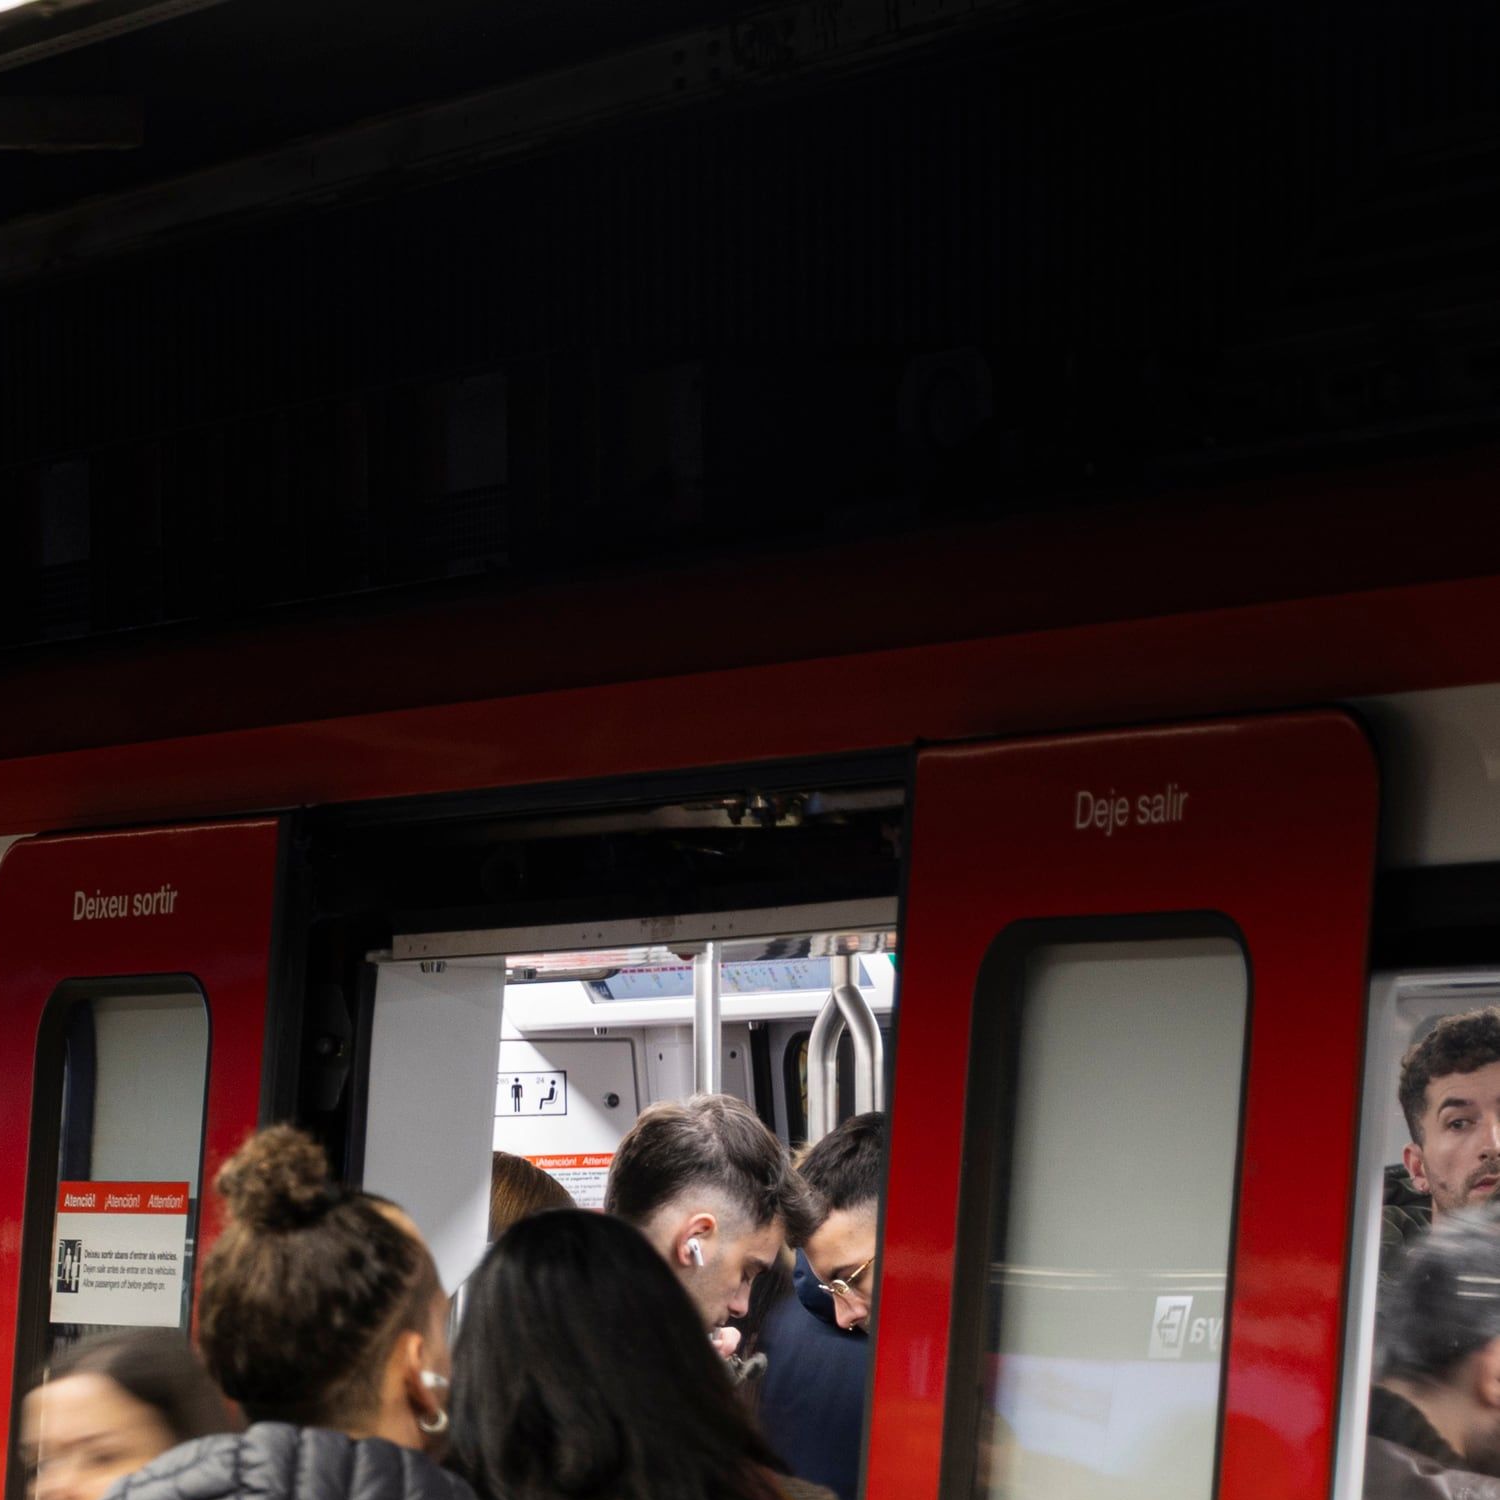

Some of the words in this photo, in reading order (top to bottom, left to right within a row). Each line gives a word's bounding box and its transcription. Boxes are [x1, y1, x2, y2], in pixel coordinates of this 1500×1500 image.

[1076, 788, 1129, 836] Deje
[1137, 784, 1188, 824] salir
[73, 889, 128, 920] Deixeu
[133, 883, 178, 916] sortir
[64, 1193, 96, 1208] Atenció!
[104, 1194, 141, 1210] ¡Atención!
[148, 1194, 184, 1209] Attention!
